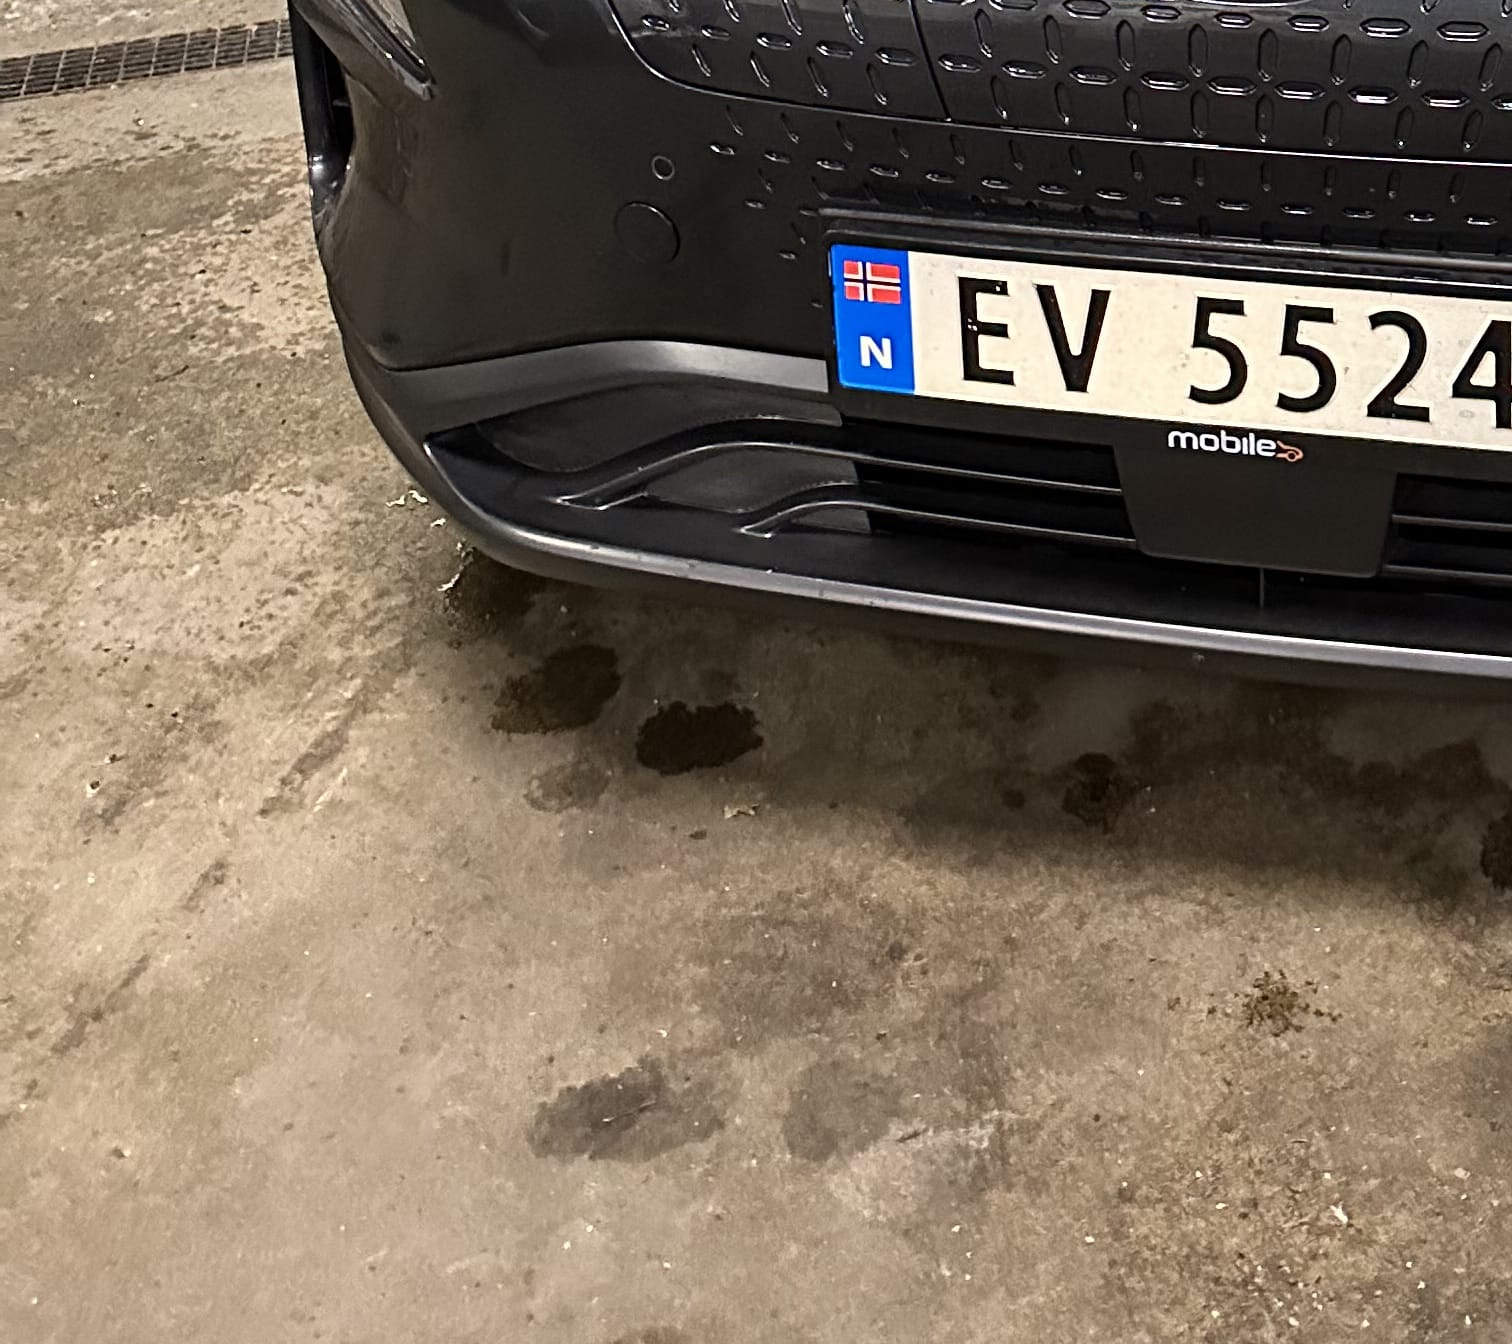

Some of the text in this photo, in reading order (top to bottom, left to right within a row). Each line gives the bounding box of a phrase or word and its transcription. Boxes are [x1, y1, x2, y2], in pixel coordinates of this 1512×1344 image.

[958, 276, 1112, 393] EV
[859, 335, 893, 370] N
[1167, 429, 1277, 457] mobile
